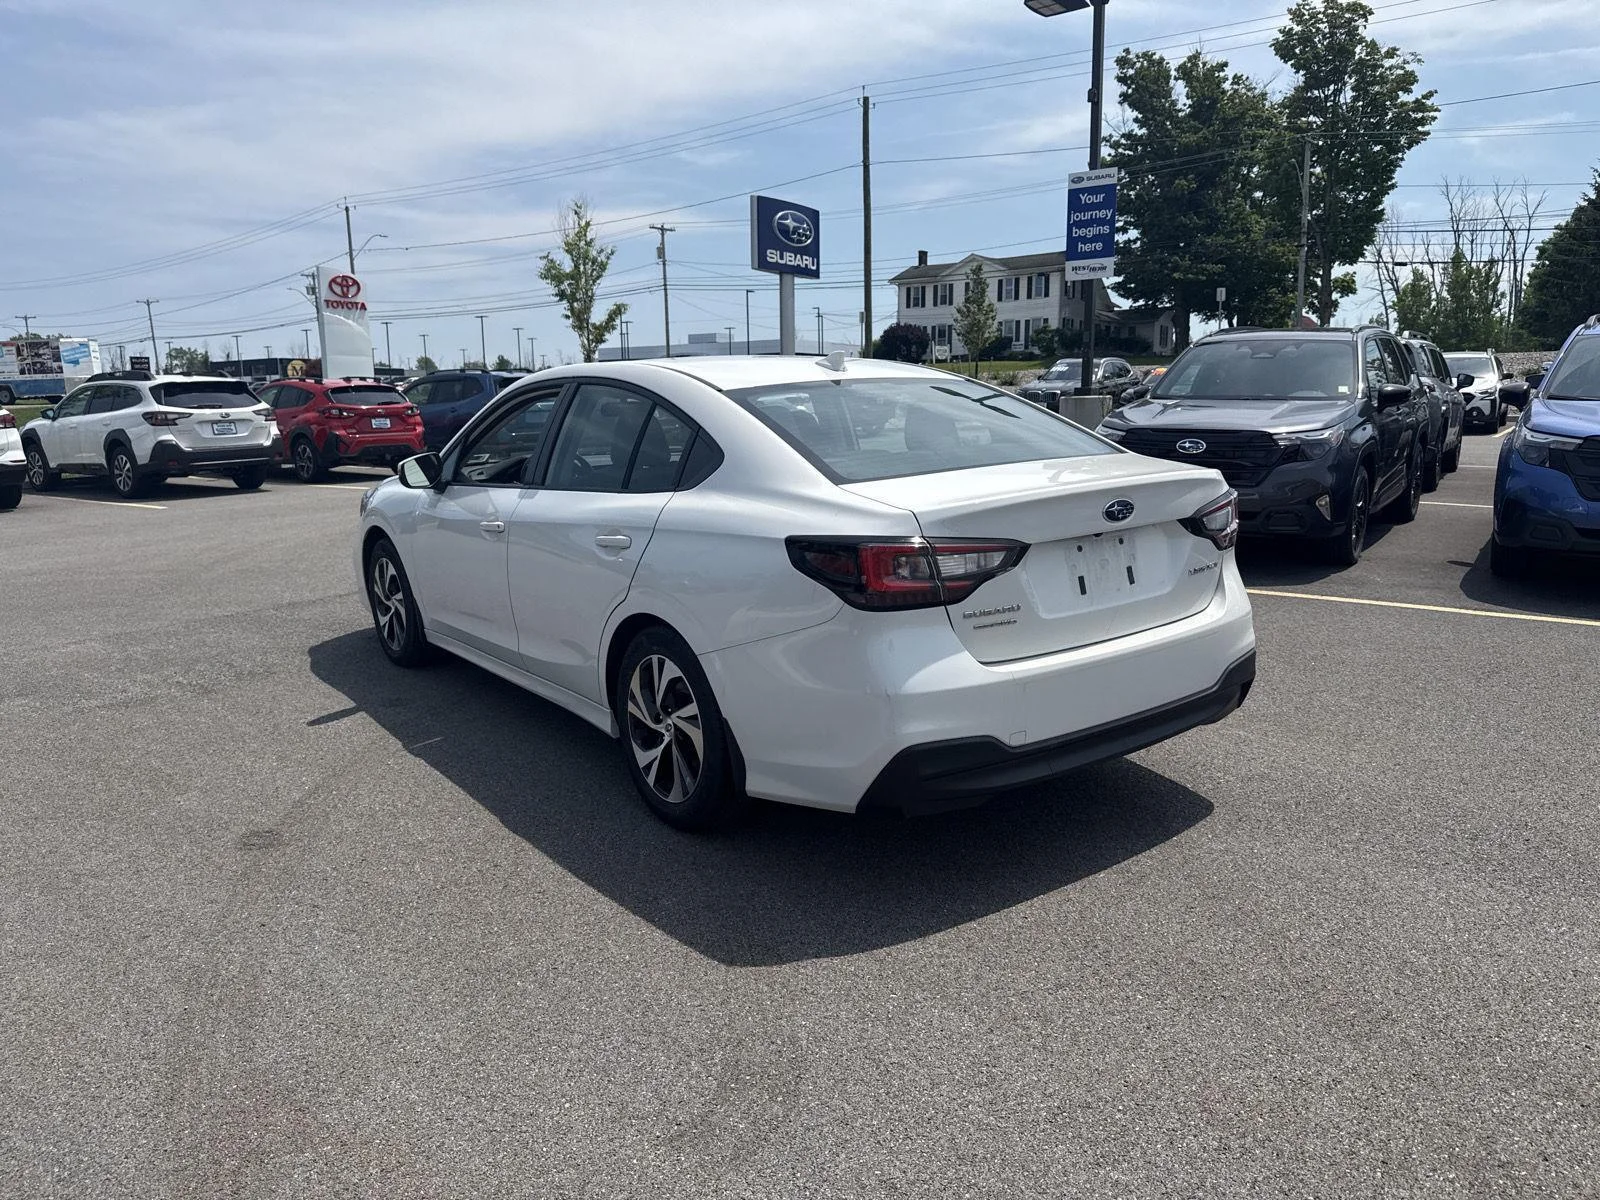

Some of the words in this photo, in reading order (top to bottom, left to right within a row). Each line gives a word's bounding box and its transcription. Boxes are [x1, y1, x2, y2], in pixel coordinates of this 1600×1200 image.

[1085, 173, 1115, 182] SUBARU
[1080, 193, 1106, 205] Your
[1070, 209, 1113, 224] journey
[1072, 224, 1110, 238] begins
[1078, 241, 1103, 253] here
[766, 249, 817, 270] SUBARU
[323, 299, 368, 311] TOYOTA
[962, 603, 1021, 619] SUBARU
